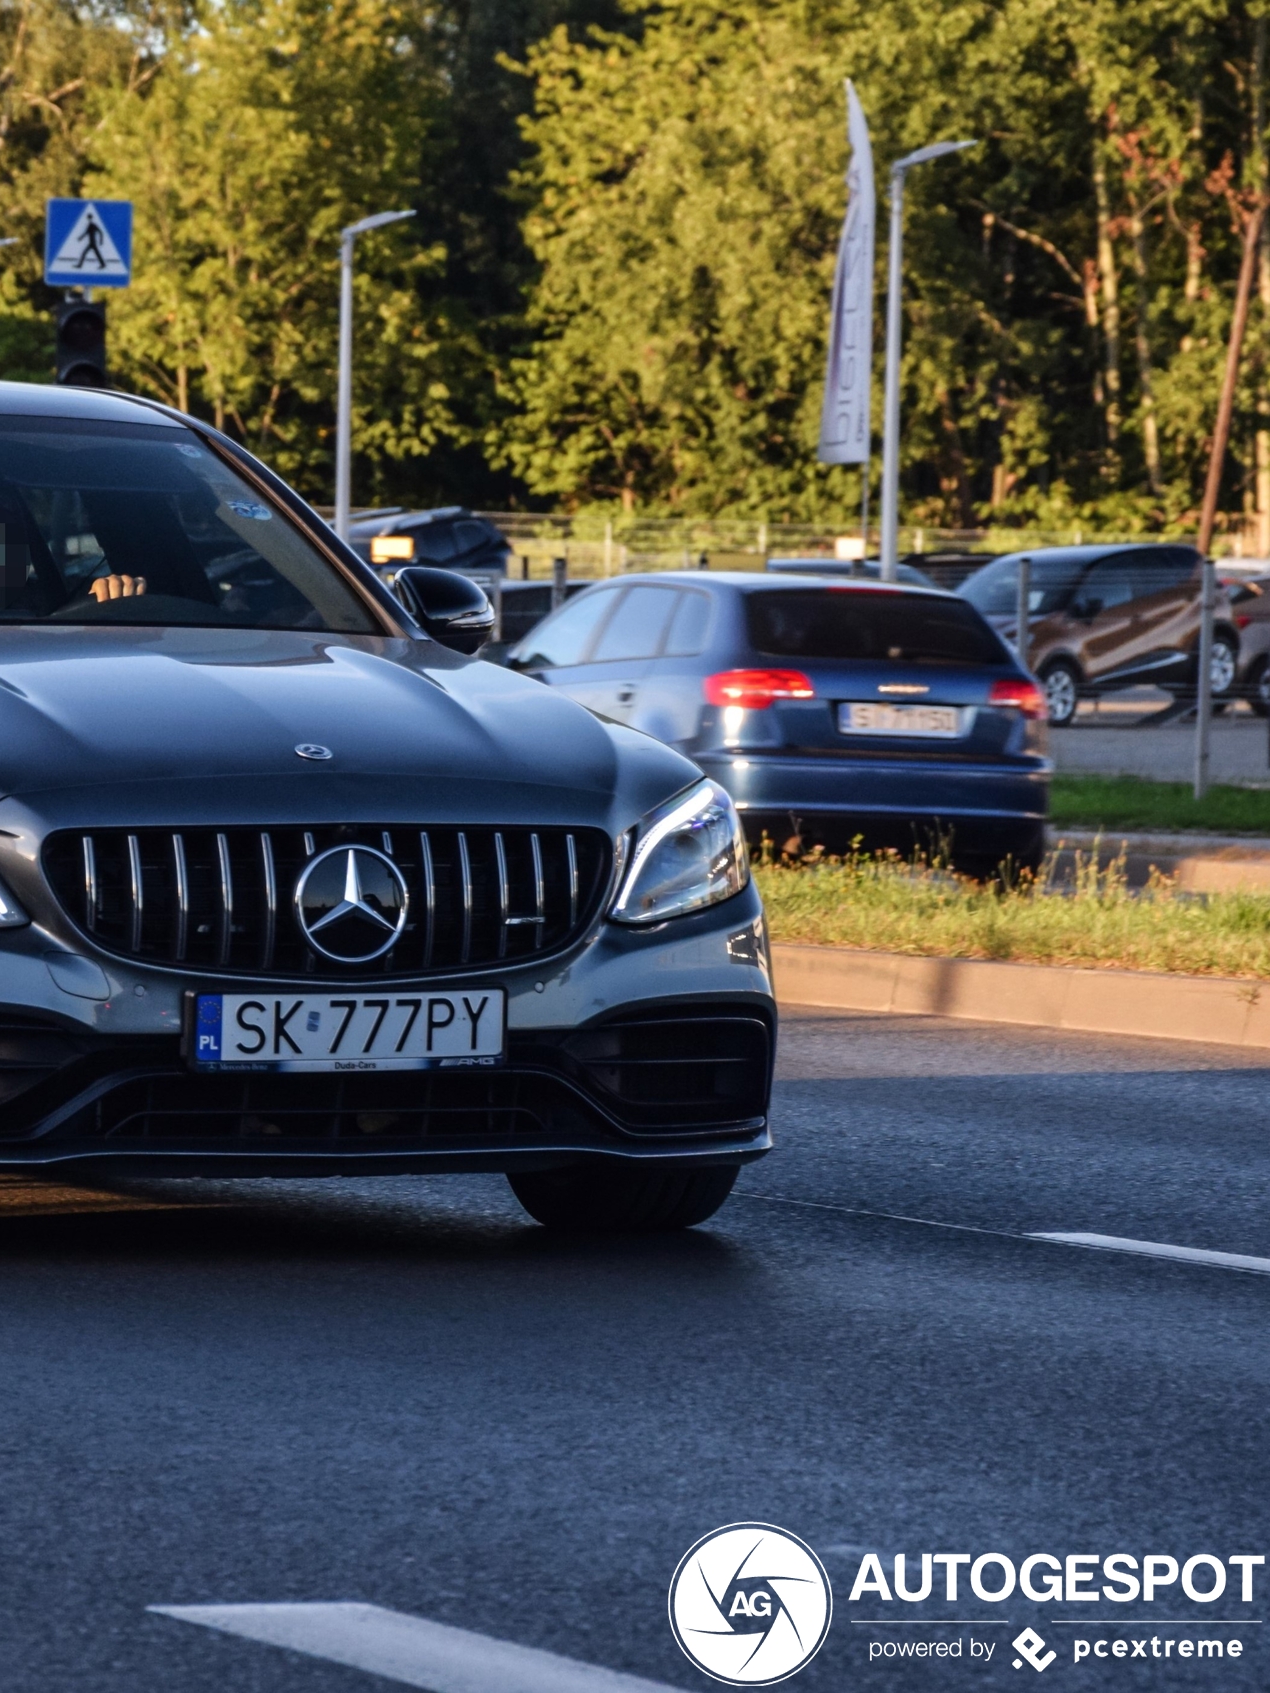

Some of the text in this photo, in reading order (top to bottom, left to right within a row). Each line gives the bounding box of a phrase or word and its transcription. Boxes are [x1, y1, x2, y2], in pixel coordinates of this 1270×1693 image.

[235, 996, 490, 1055] SK 777PY
[199, 1035, 218, 1051] PL
[334, 1060, 377, 1070] Duda-Cars
[457, 1057, 496, 1066] AMG
